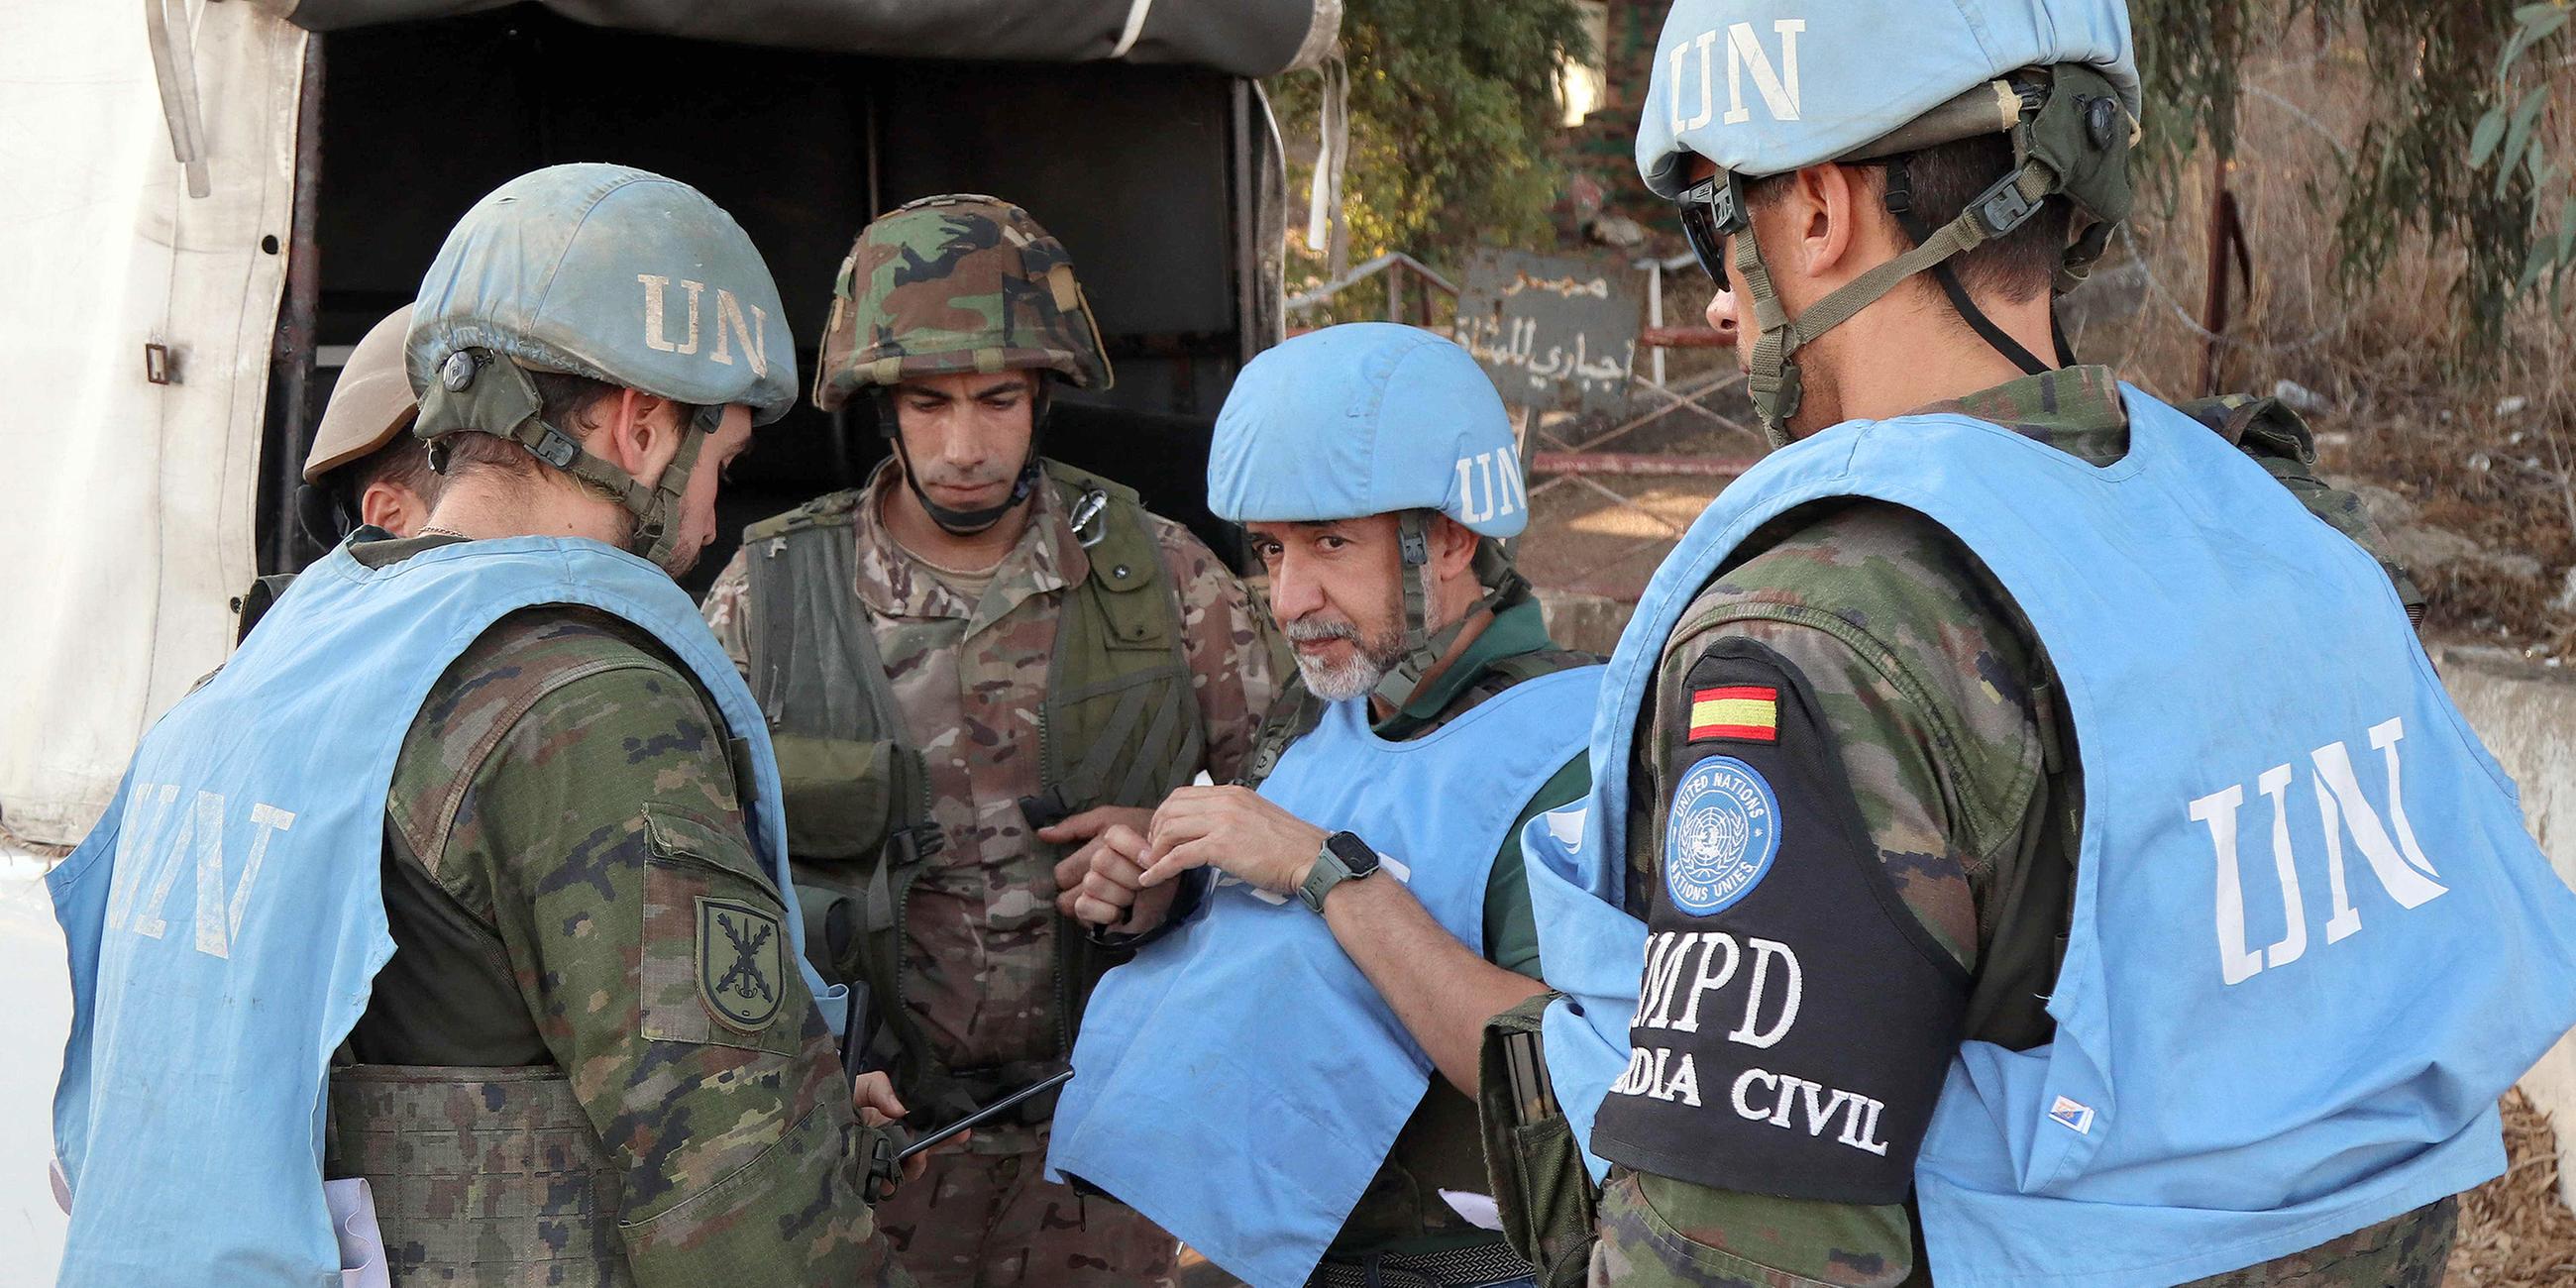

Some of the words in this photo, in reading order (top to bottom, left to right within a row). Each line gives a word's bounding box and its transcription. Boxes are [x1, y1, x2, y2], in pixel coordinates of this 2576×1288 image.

[1668, 19, 1805, 137] UN
[637, 273, 769, 379] UN
[1455, 443, 1527, 524] UN
[1675, 775, 1709, 818] UNITED
[1713, 772, 1765, 819] NATIONS
[108, 783, 297, 960] UN
[1670, 859, 1709, 902] NATIONS
[1713, 860, 1756, 898] UNIES
[2189, 716, 2449, 985] UN
[1731, 1067, 1889, 1157] CIVIL
